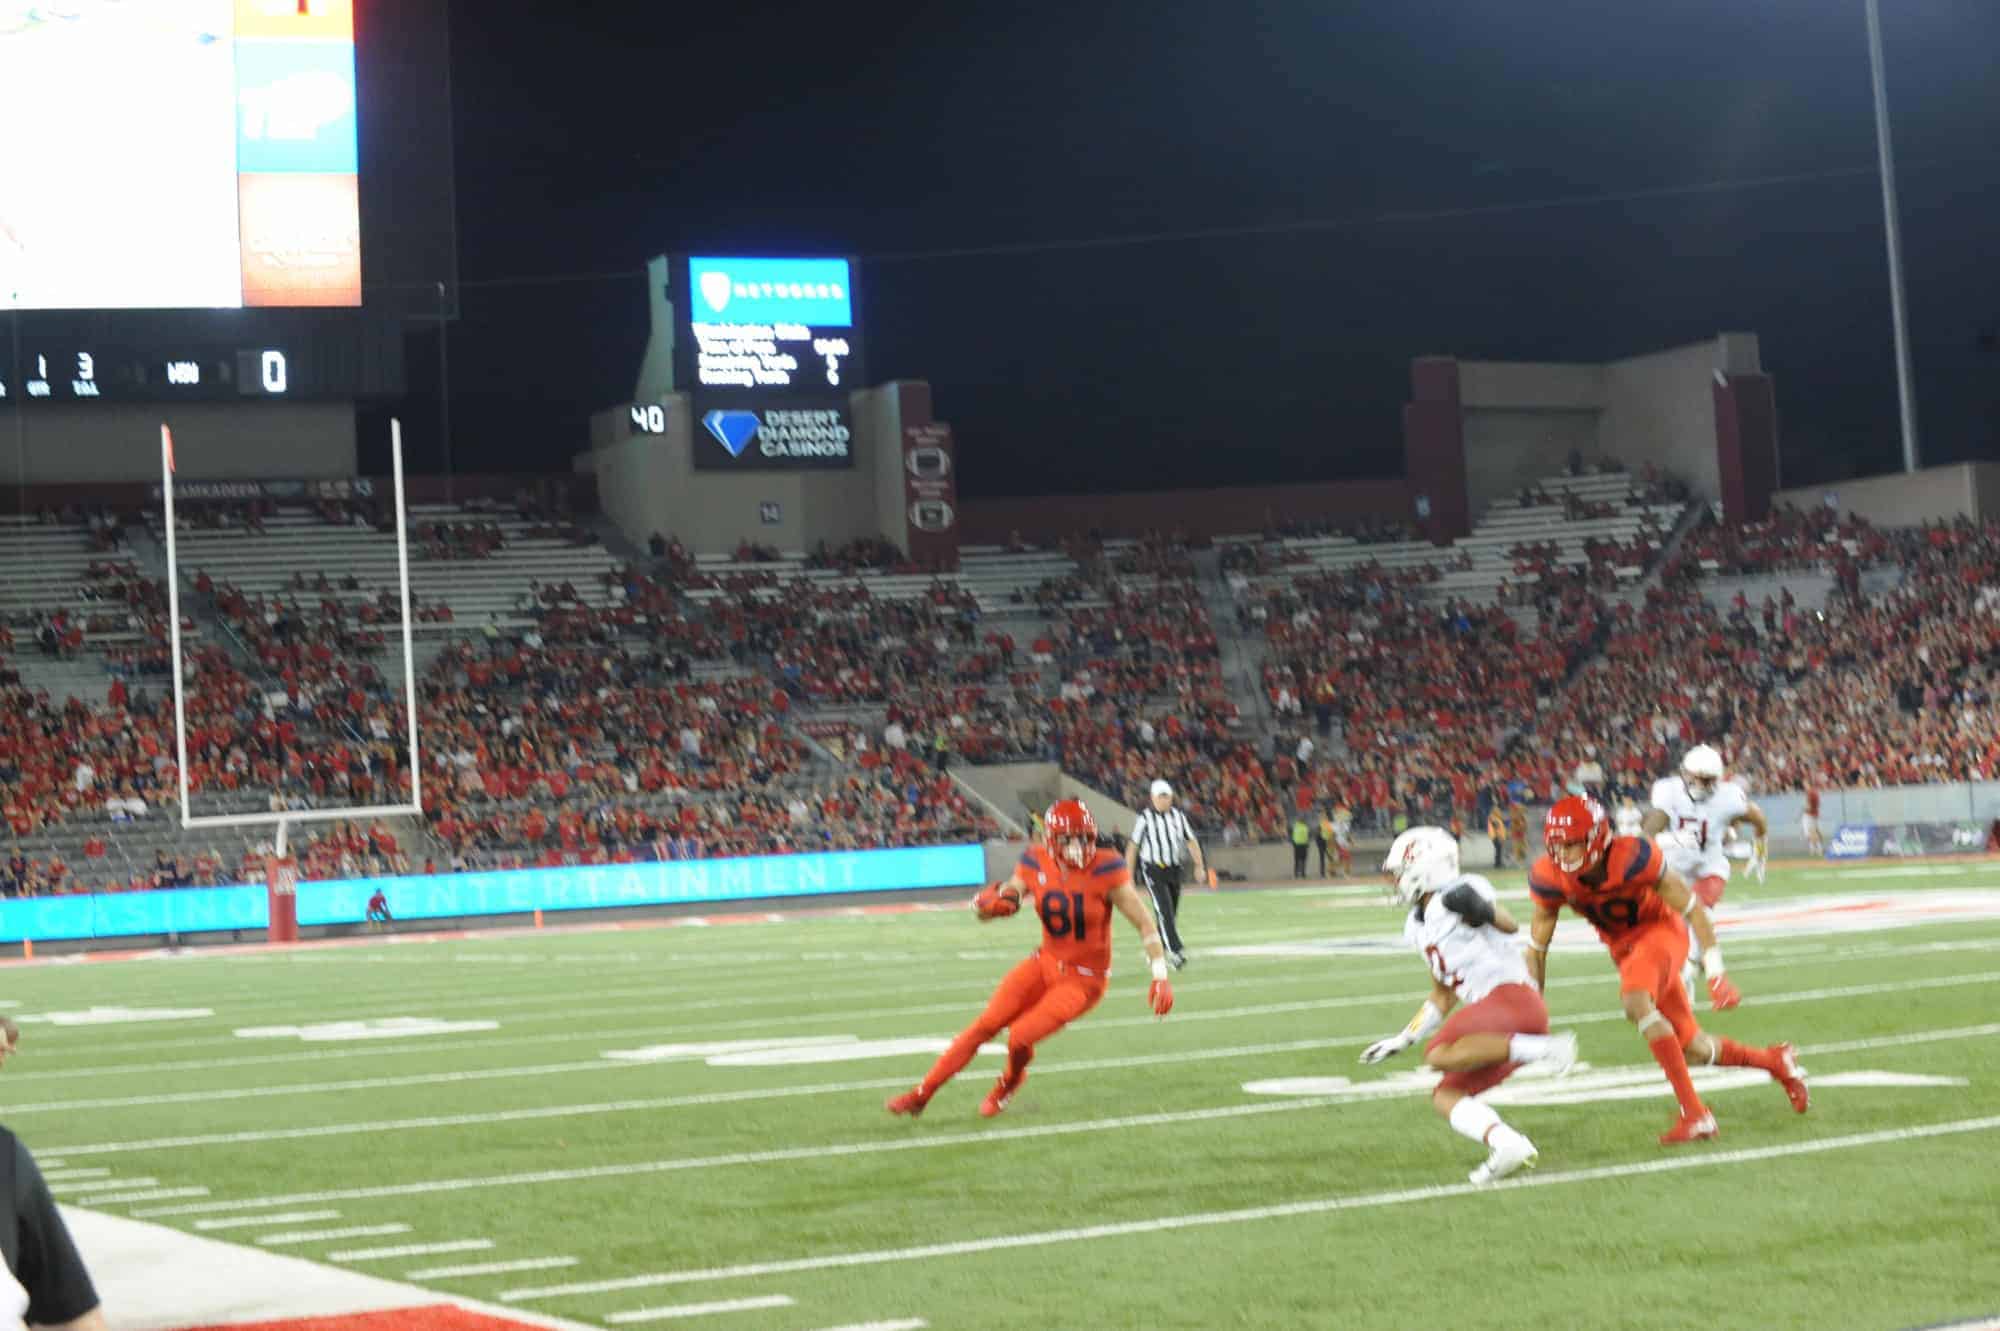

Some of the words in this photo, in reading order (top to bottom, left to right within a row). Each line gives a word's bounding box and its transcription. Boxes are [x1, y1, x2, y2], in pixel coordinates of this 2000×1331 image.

[78, 352, 94, 379] 3
[261, 350, 287, 393] 0
[631, 406, 665, 433] 40
[765, 410, 840, 427] DESERT
[757, 425, 850, 441] DIAMOND
[760, 440, 849, 457] CASINOS
[391, 857, 860, 913] ENTERTAINMENT
[1041, 890, 1087, 942] 81
